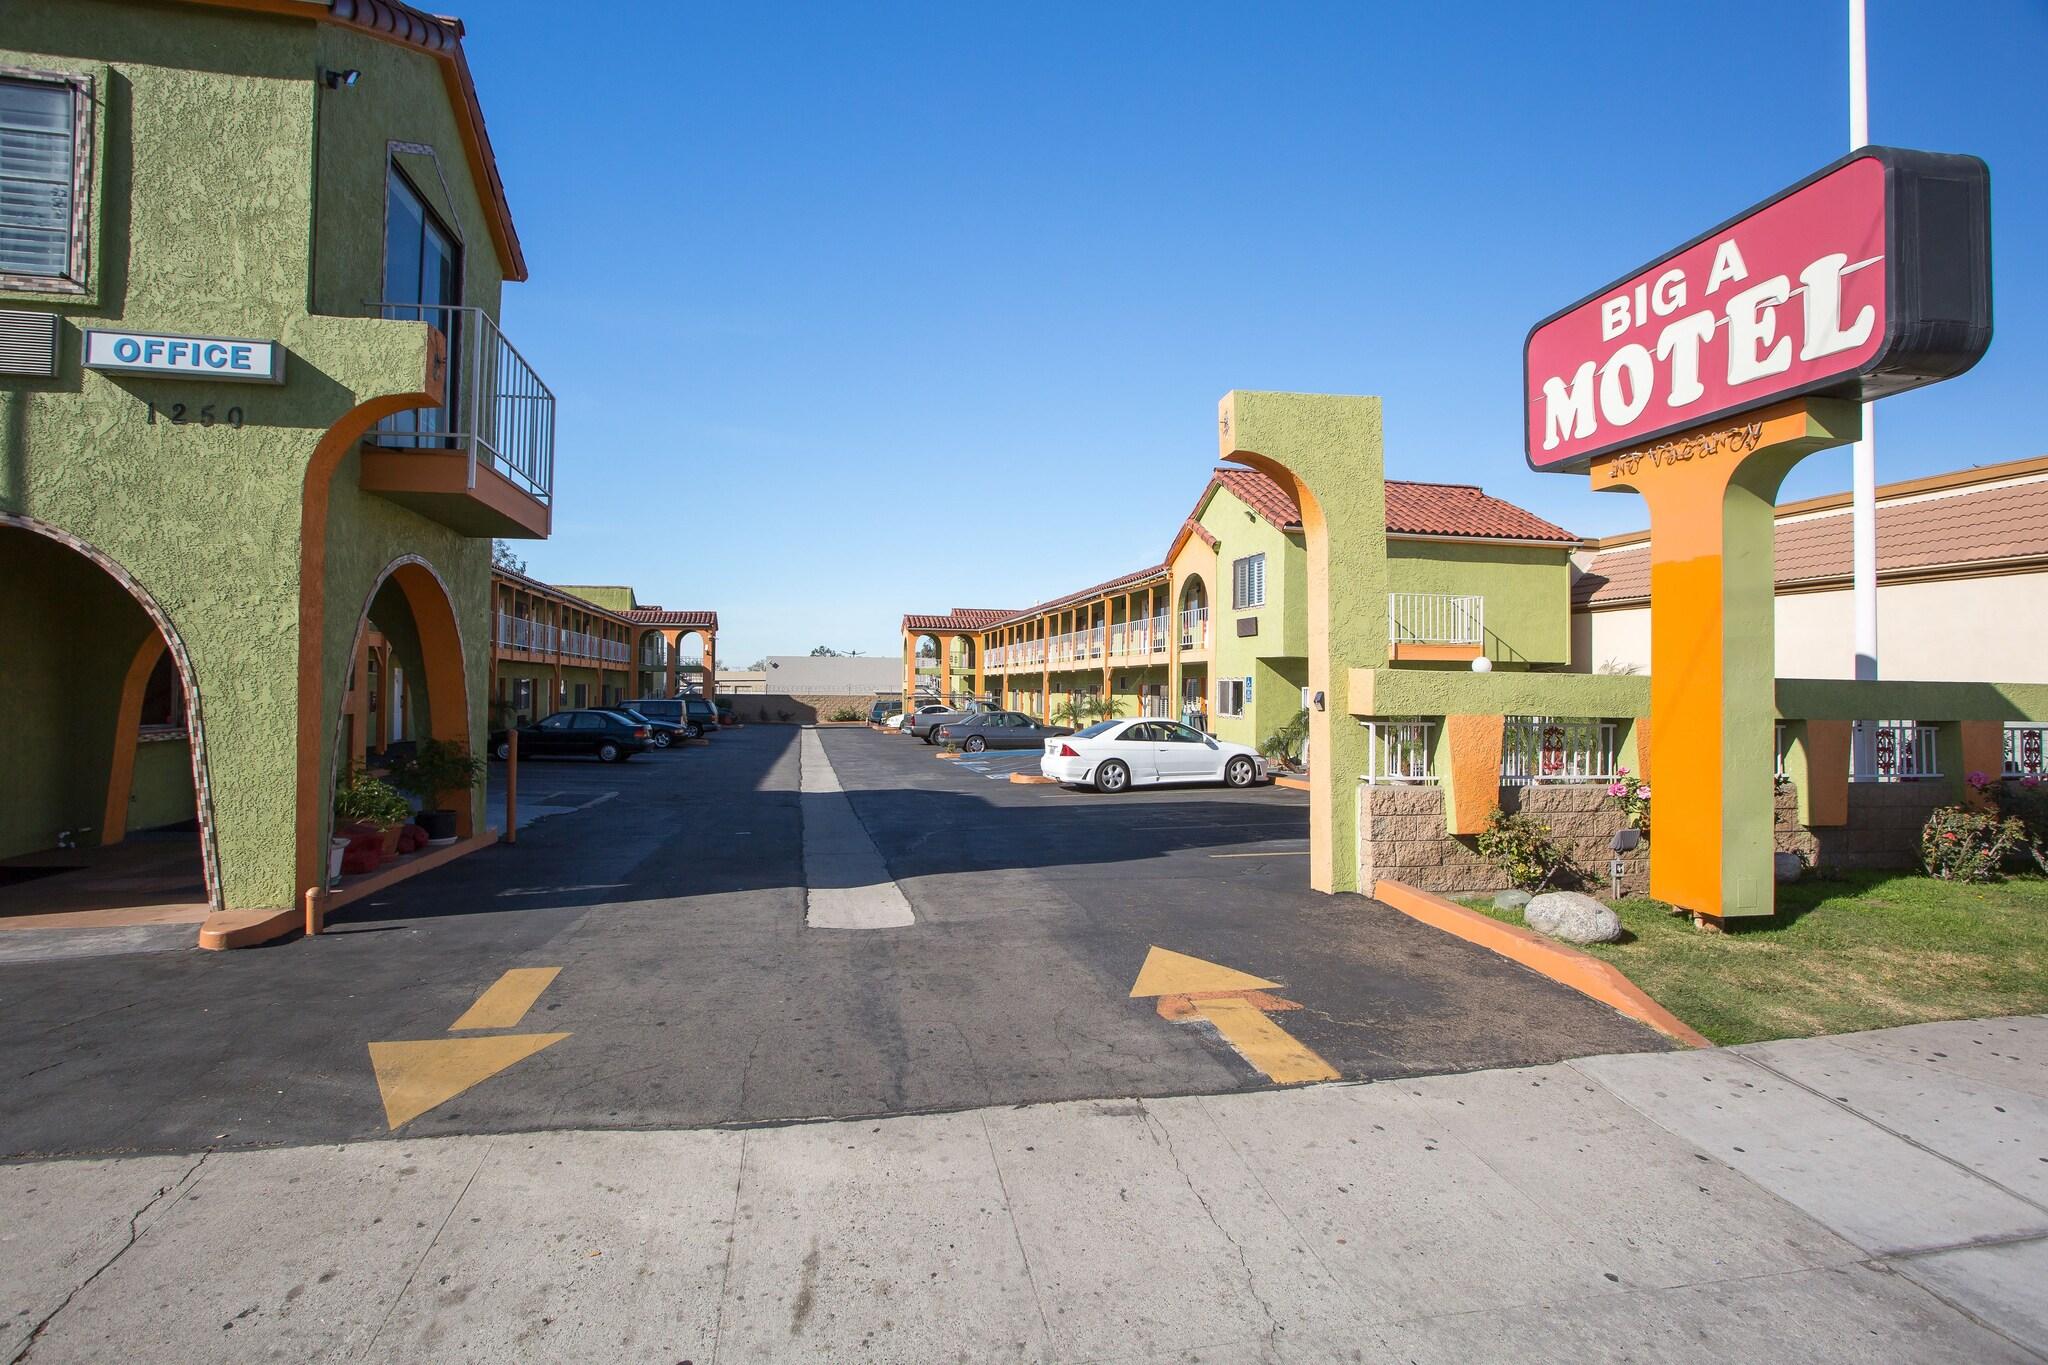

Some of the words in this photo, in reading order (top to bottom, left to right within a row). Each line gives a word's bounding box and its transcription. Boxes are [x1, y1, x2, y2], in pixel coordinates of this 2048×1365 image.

[1601, 268, 1687, 342] BIG
[1704, 238, 1749, 297] A
[113, 337, 252, 370] OFFICE
[1543, 252, 1876, 451] MOTEL
[147, 402, 244, 429] 1250
